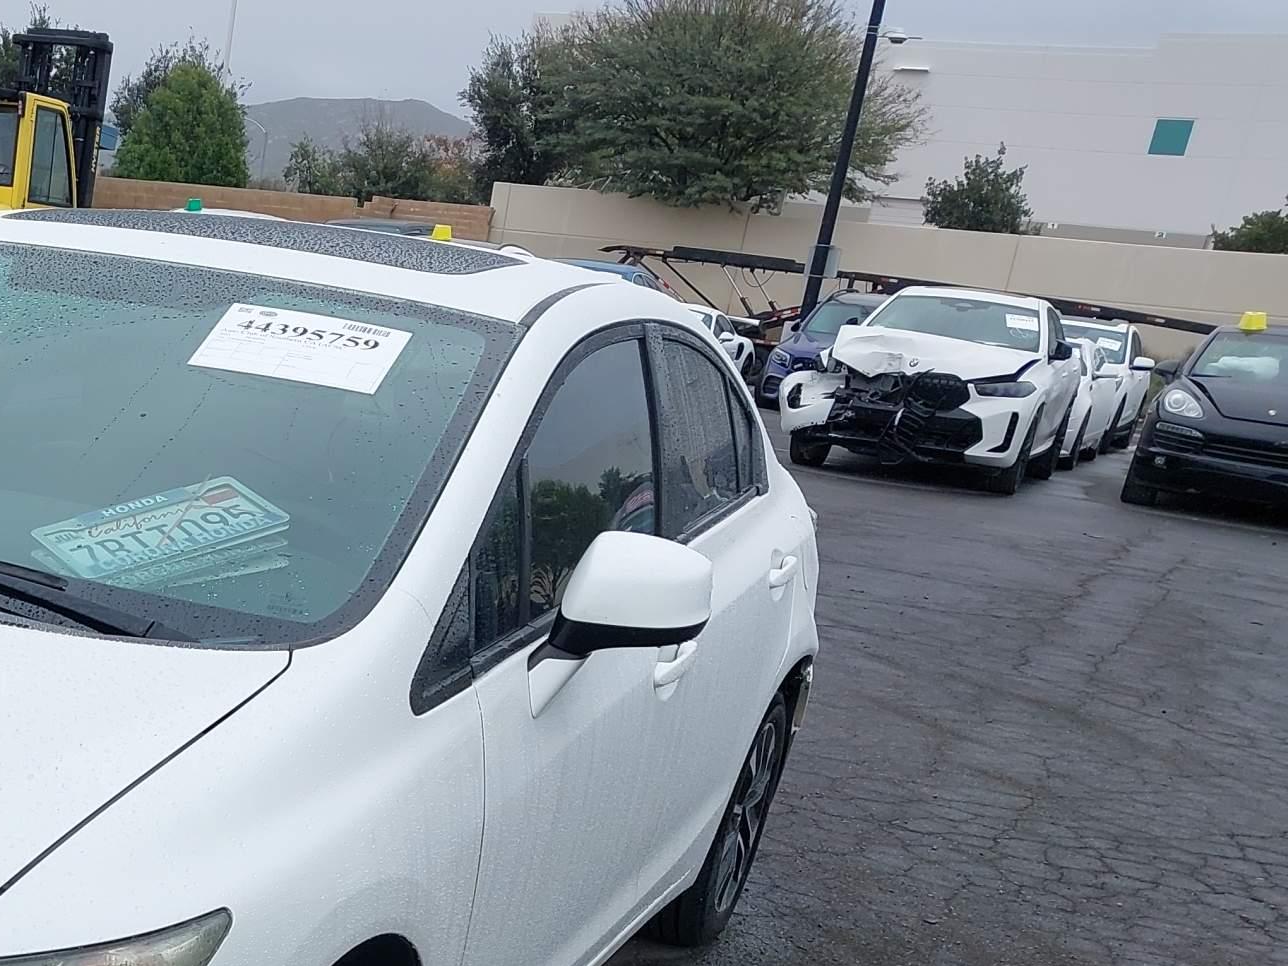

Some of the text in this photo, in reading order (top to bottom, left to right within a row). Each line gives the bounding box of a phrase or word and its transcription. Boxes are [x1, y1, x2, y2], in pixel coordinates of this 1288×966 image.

[237, 319, 380, 351] 44395759
[102, 495, 169, 517] HONDA
[195, 513, 272, 545] HONDA
